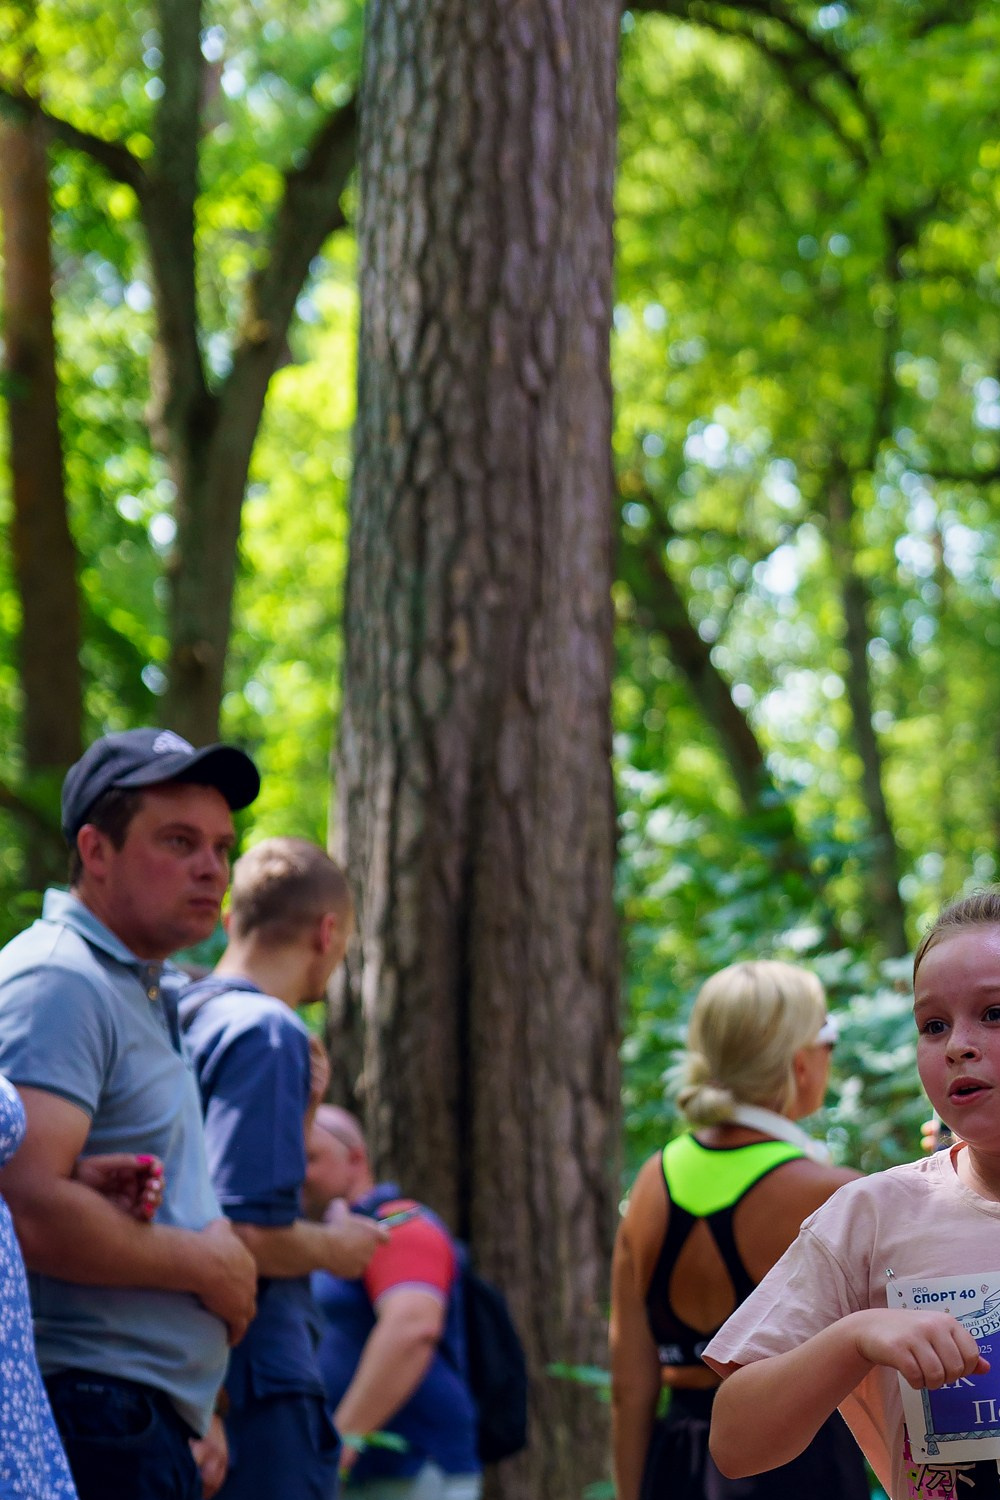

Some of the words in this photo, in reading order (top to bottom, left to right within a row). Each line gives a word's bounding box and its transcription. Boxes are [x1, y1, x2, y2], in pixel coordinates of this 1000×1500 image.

[912, 1286, 928, 1294] PRO
[913, 1291, 957, 1304] СПОРТ
[959, 1289, 976, 1300] 40
[962, 1320, 980, 1329] ный
